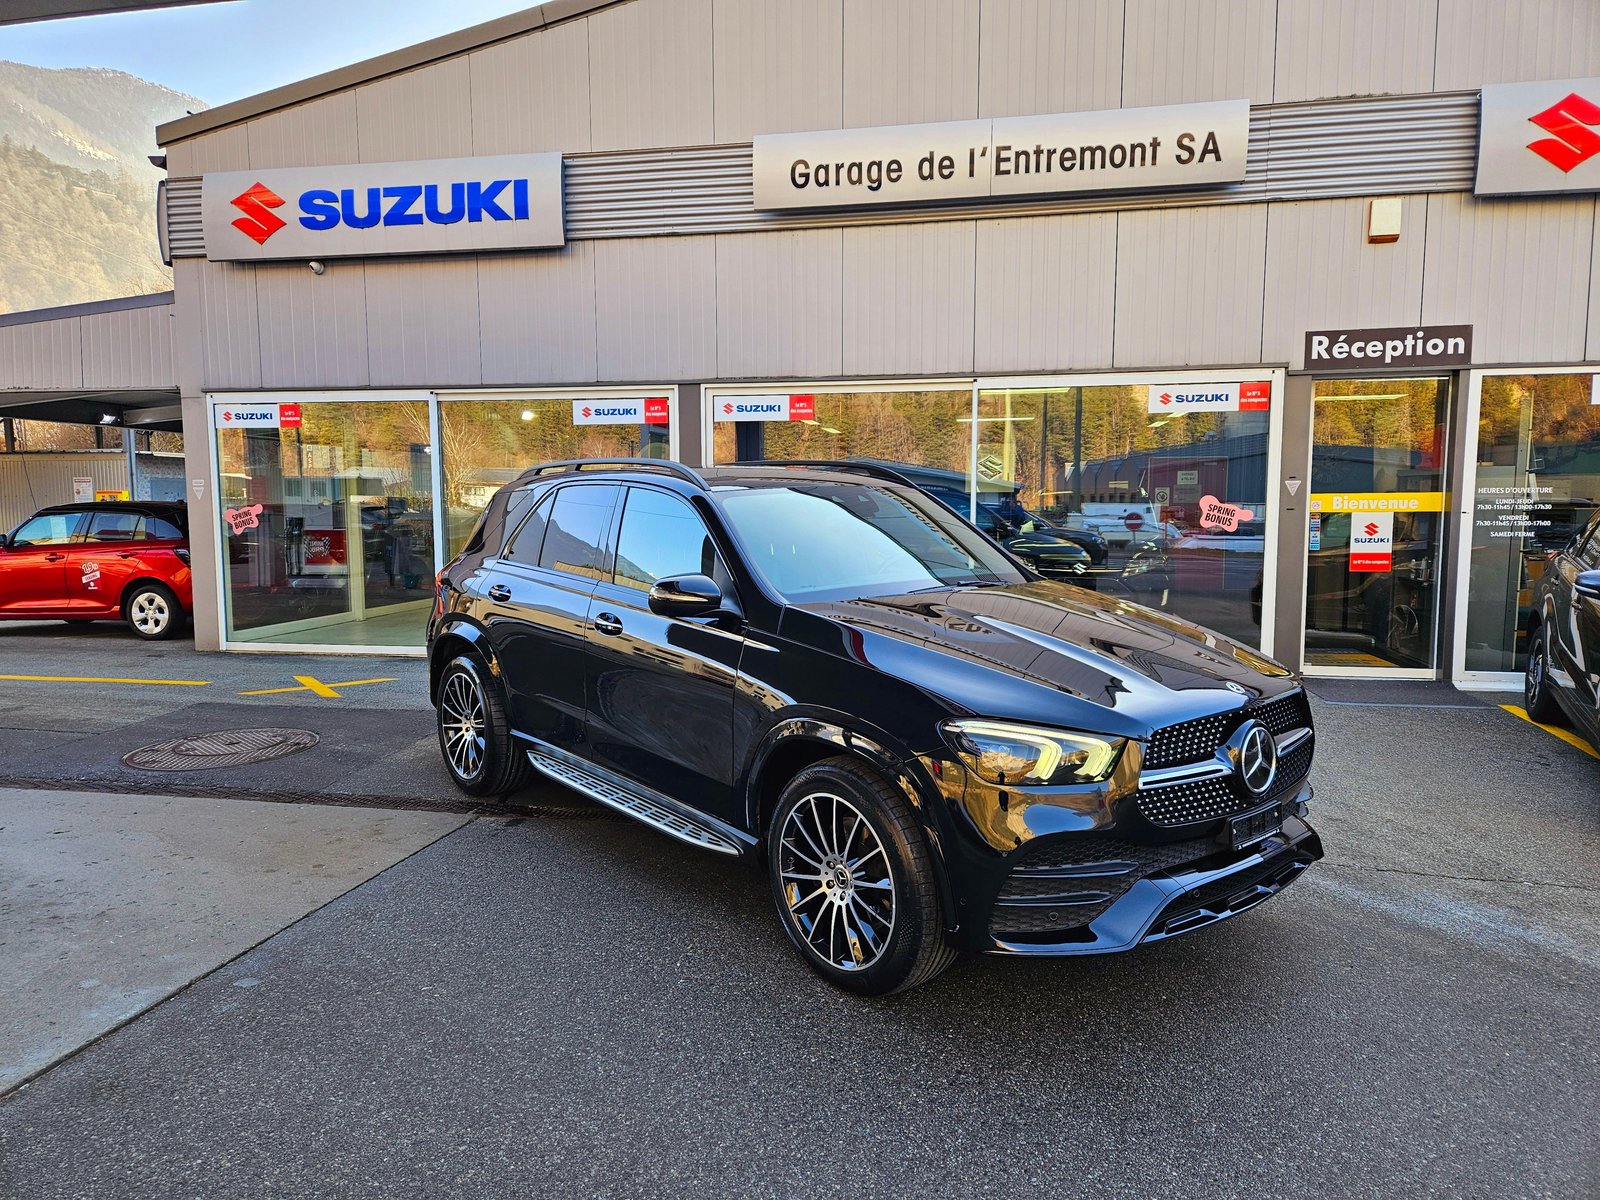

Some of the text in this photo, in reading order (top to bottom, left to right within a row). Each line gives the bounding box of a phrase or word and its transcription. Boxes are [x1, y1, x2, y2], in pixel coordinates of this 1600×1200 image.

[790, 159, 903, 192] Garage
[918, 151, 955, 181] de
[1175, 131, 1222, 165] SA
[298, 179, 530, 231] SUZUKI
[1311, 331, 1465, 363] Réception
[1175, 393, 1229, 403] SUZUKI
[234, 412, 273, 420] SUZUKI
[594, 408, 637, 416] SUZUKI
[1332, 496, 1419, 509] Bienvenue
[231, 510, 252, 521] SPRING
[1207, 503, 1236, 518] SPRING
[233, 516, 254, 530] BONUS
[1204, 512, 1233, 527] BONUS
